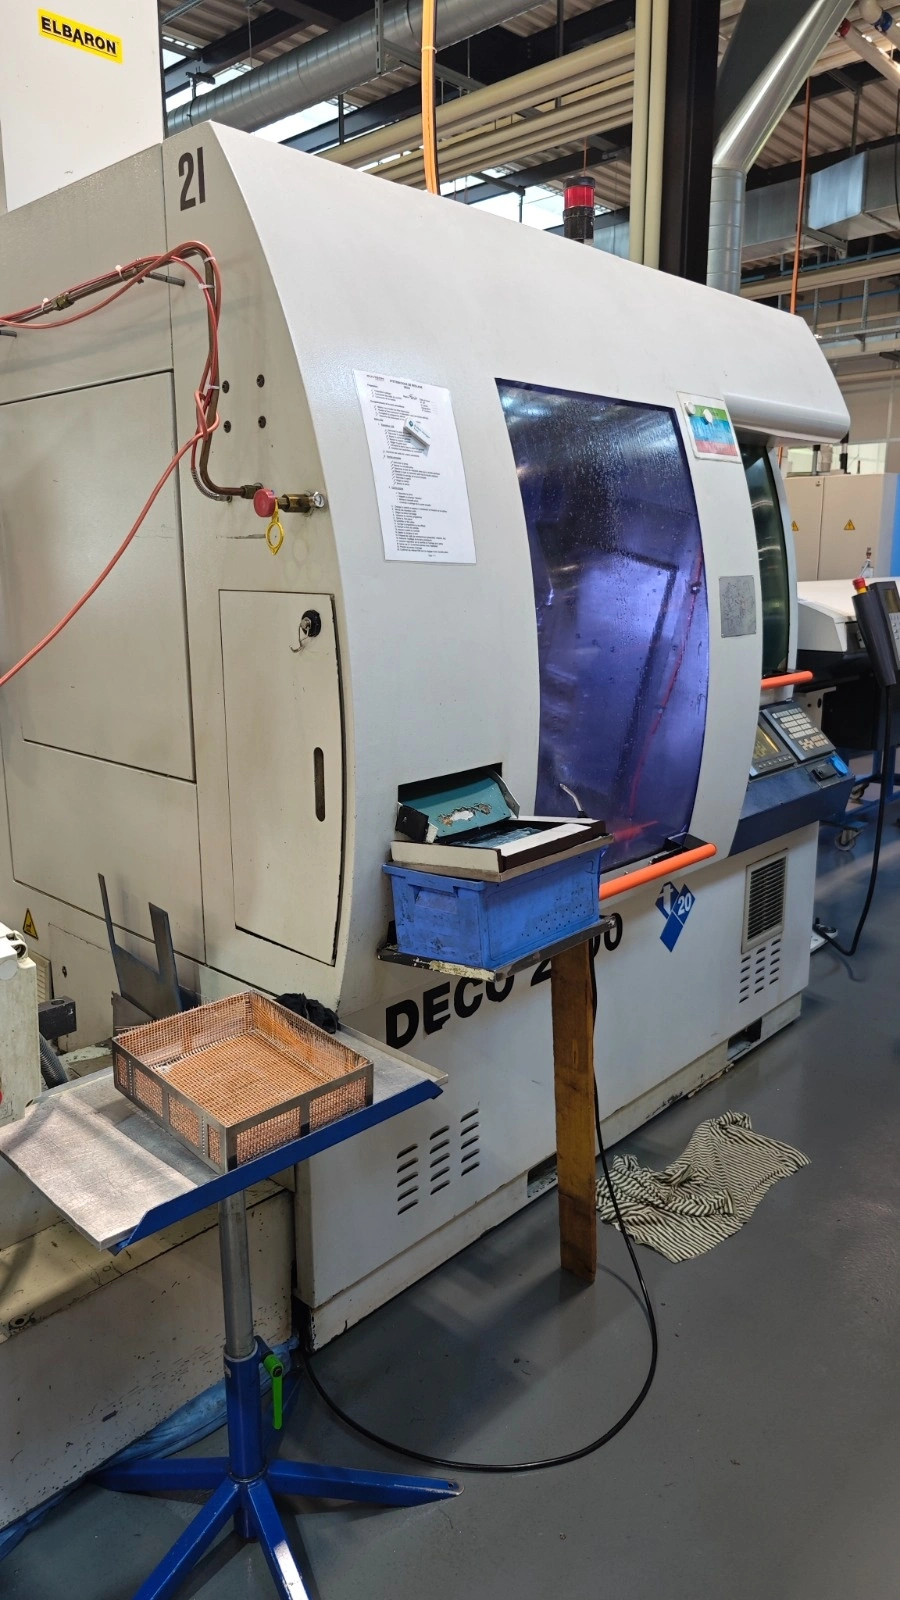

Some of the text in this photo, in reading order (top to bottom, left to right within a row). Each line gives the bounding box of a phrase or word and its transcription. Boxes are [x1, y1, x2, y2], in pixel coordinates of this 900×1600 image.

[41, 16, 116, 54] ELBARON
[178, 146, 206, 211] 21
[677, 892, 692, 916] 20
